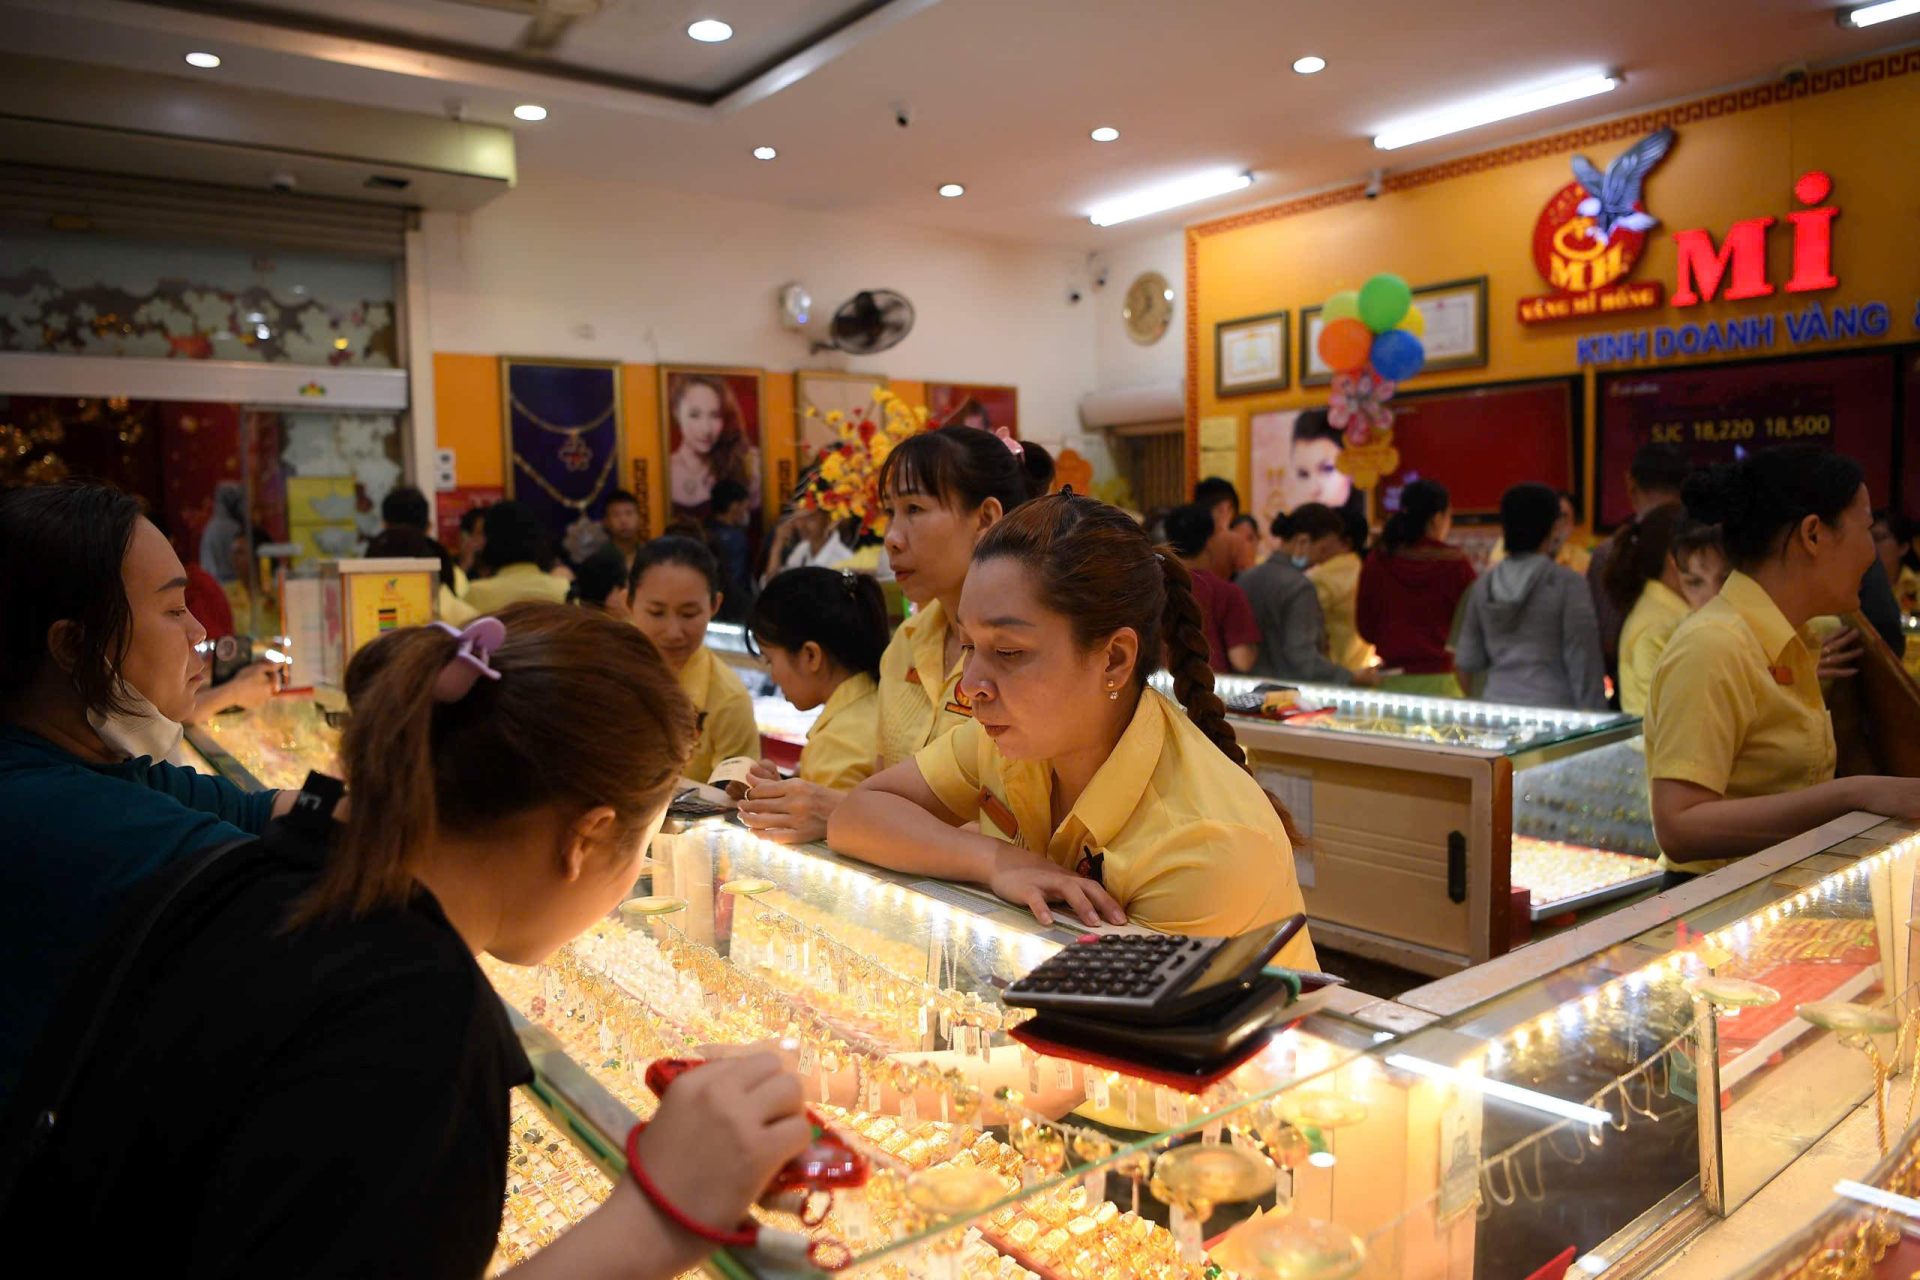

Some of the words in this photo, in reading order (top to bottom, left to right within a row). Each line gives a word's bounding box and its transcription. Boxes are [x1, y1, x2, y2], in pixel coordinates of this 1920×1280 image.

[1577, 330, 1649, 367] KINH
[1654, 317, 1774, 359] DOANH
[1785, 302, 1889, 344] VÀNG
